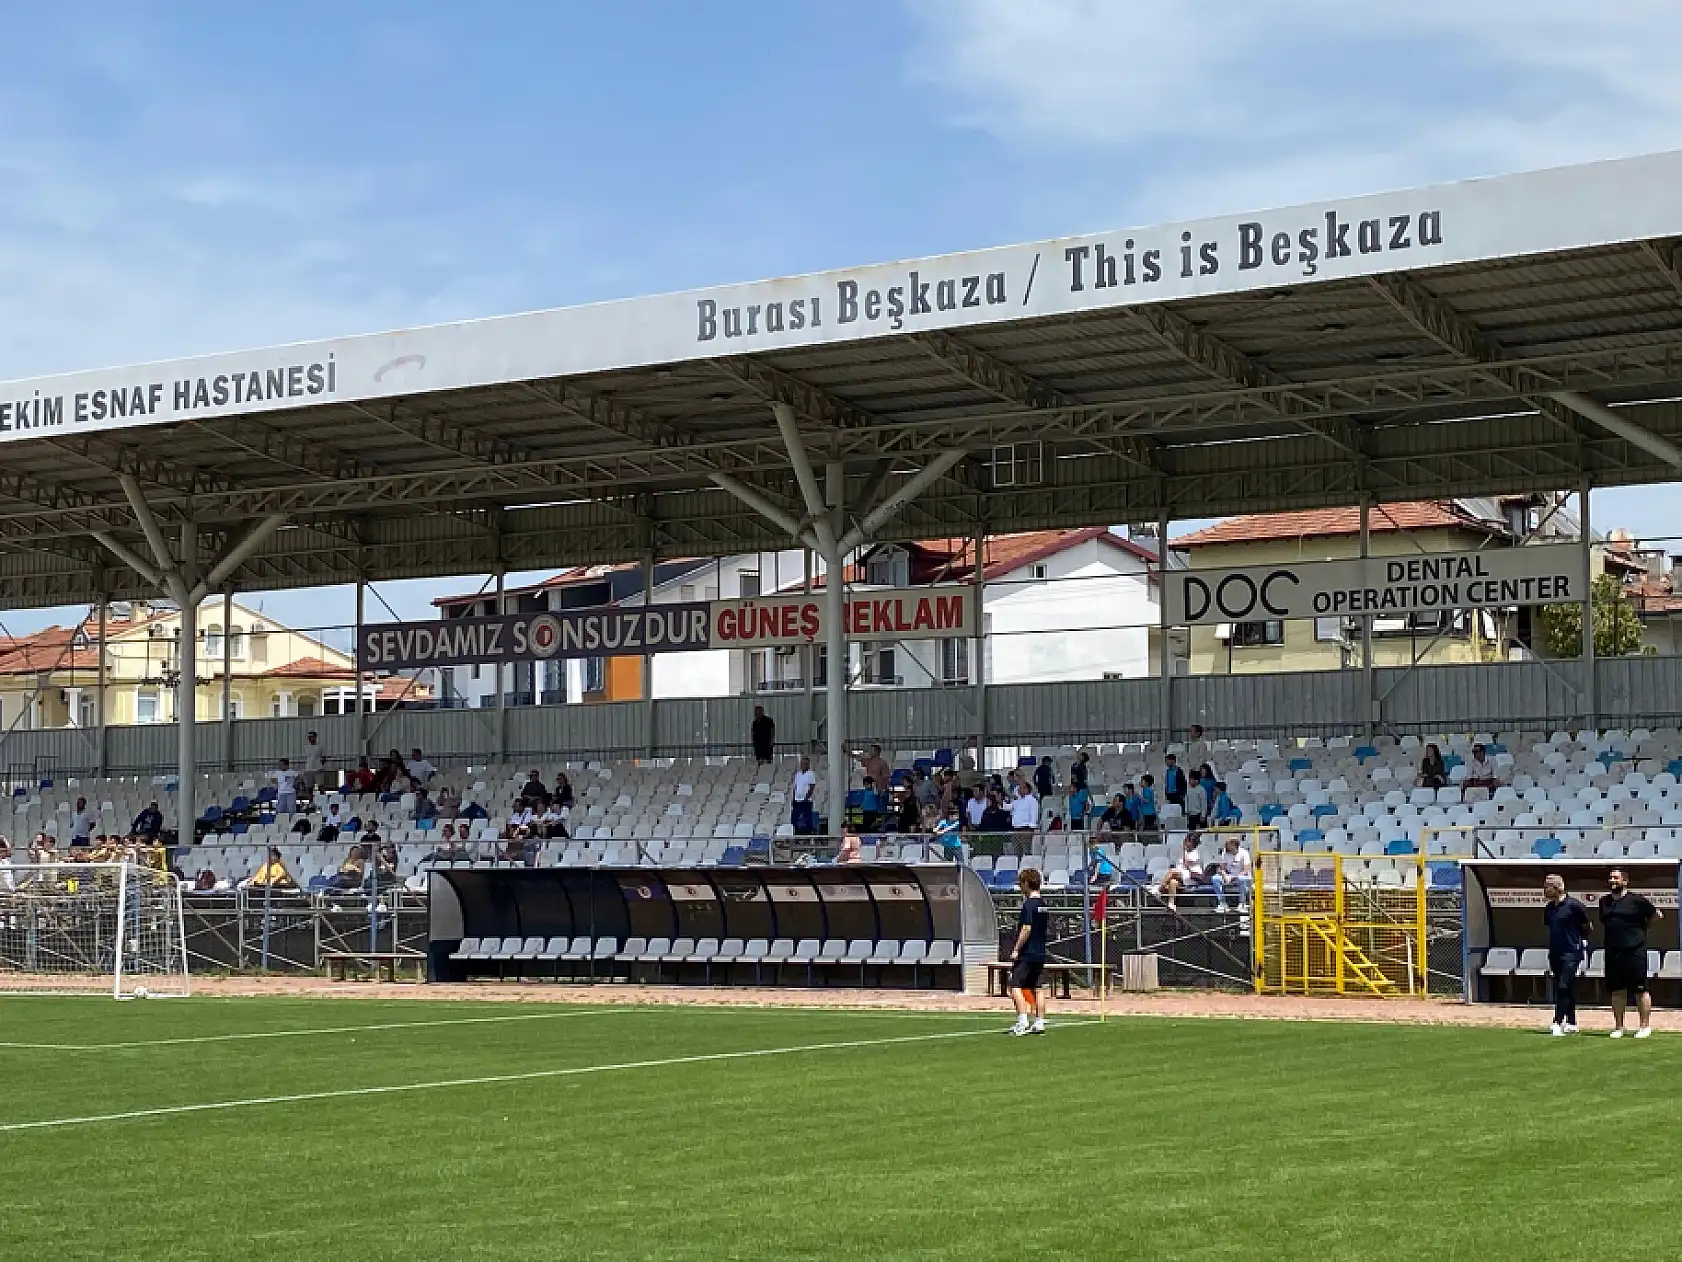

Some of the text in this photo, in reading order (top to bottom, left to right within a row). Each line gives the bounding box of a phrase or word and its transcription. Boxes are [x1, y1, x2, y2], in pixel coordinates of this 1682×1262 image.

[697, 210, 1443, 341] Burası Beşkaza / This is Beşkaza
[0, 352, 336, 431] EKİM ESNAF HASTANESİ
[1183, 569, 1300, 622] DOC
[1311, 575, 1571, 613] OPERATION CENTER
[1387, 555, 1489, 584] DENTAL
[366, 610, 706, 664] SEVDAMIZ SONSUZDUR
[717, 601, 819, 642] GÜNEŞ
